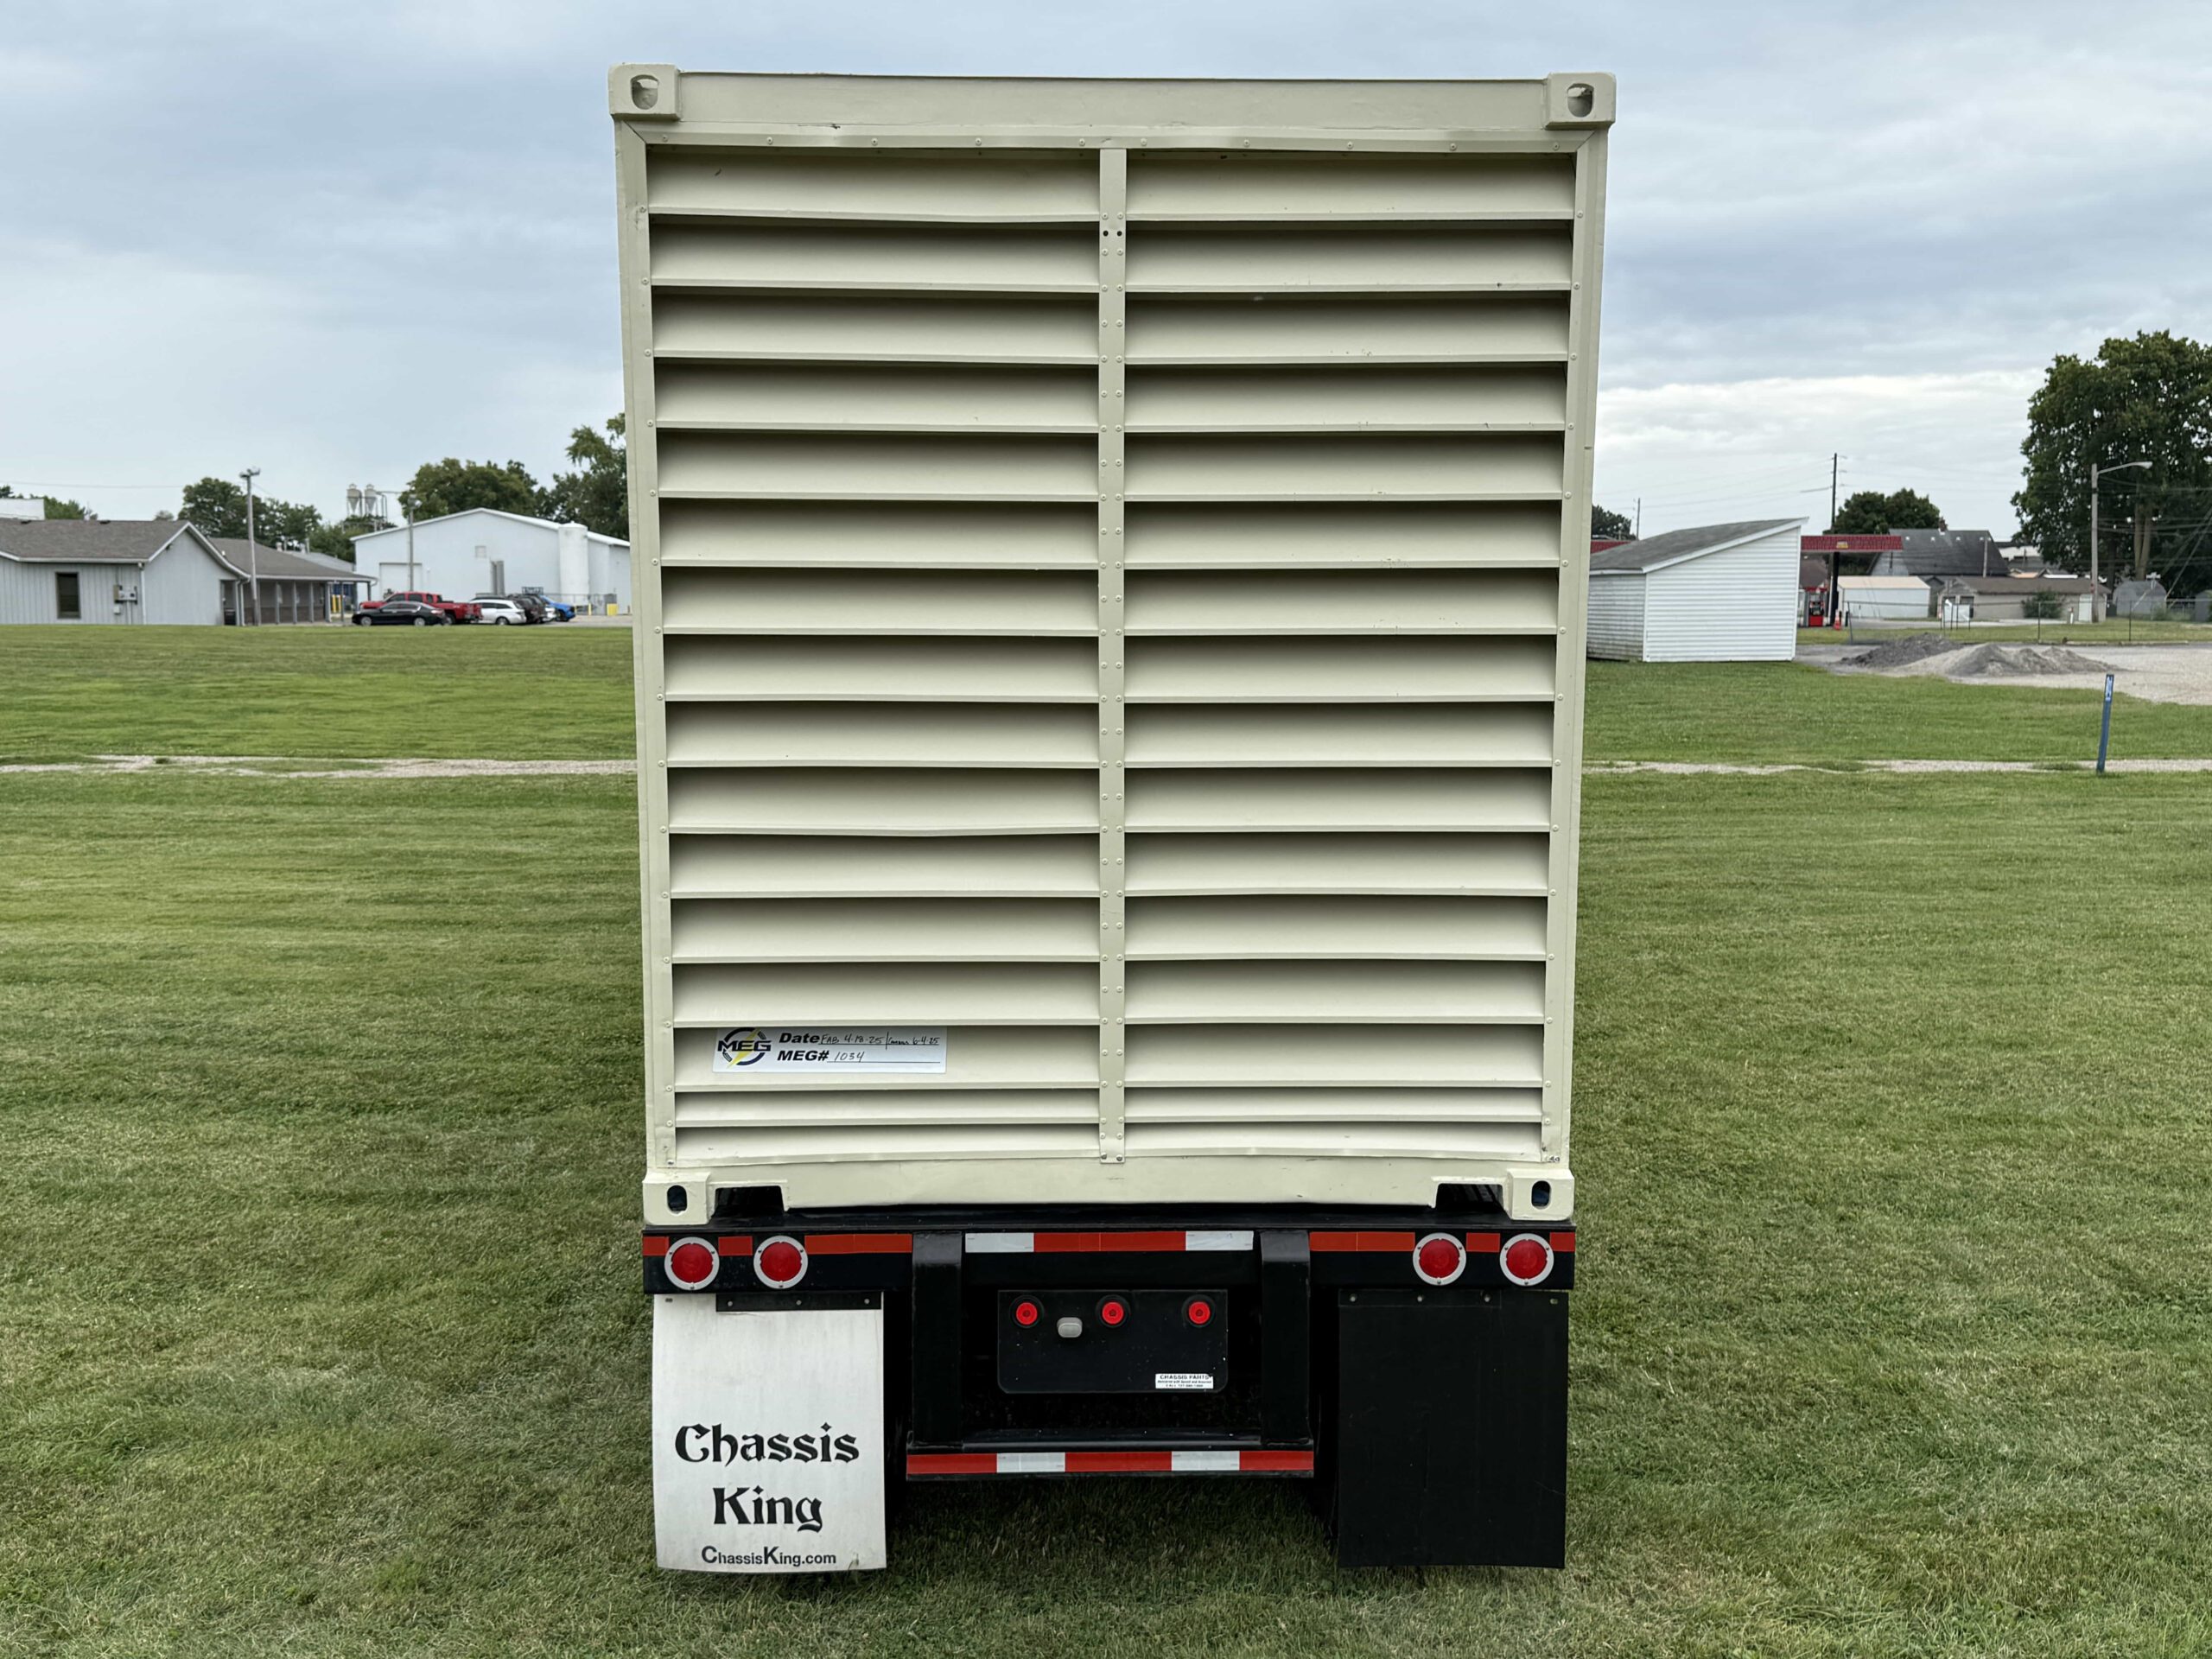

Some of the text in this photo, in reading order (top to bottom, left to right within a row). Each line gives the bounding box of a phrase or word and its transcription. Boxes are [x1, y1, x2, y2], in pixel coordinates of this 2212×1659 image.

[779, 1033, 820, 1044] Date
[717, 1040, 772, 1052] MEG
[777, 1050, 830, 1062] MEG#
[834, 1052, 865, 1063] 1034
[675, 1422, 860, 1467] Chassis
[712, 1484, 823, 1534] King
[701, 1546, 836, 1567] ChassisKing.com
